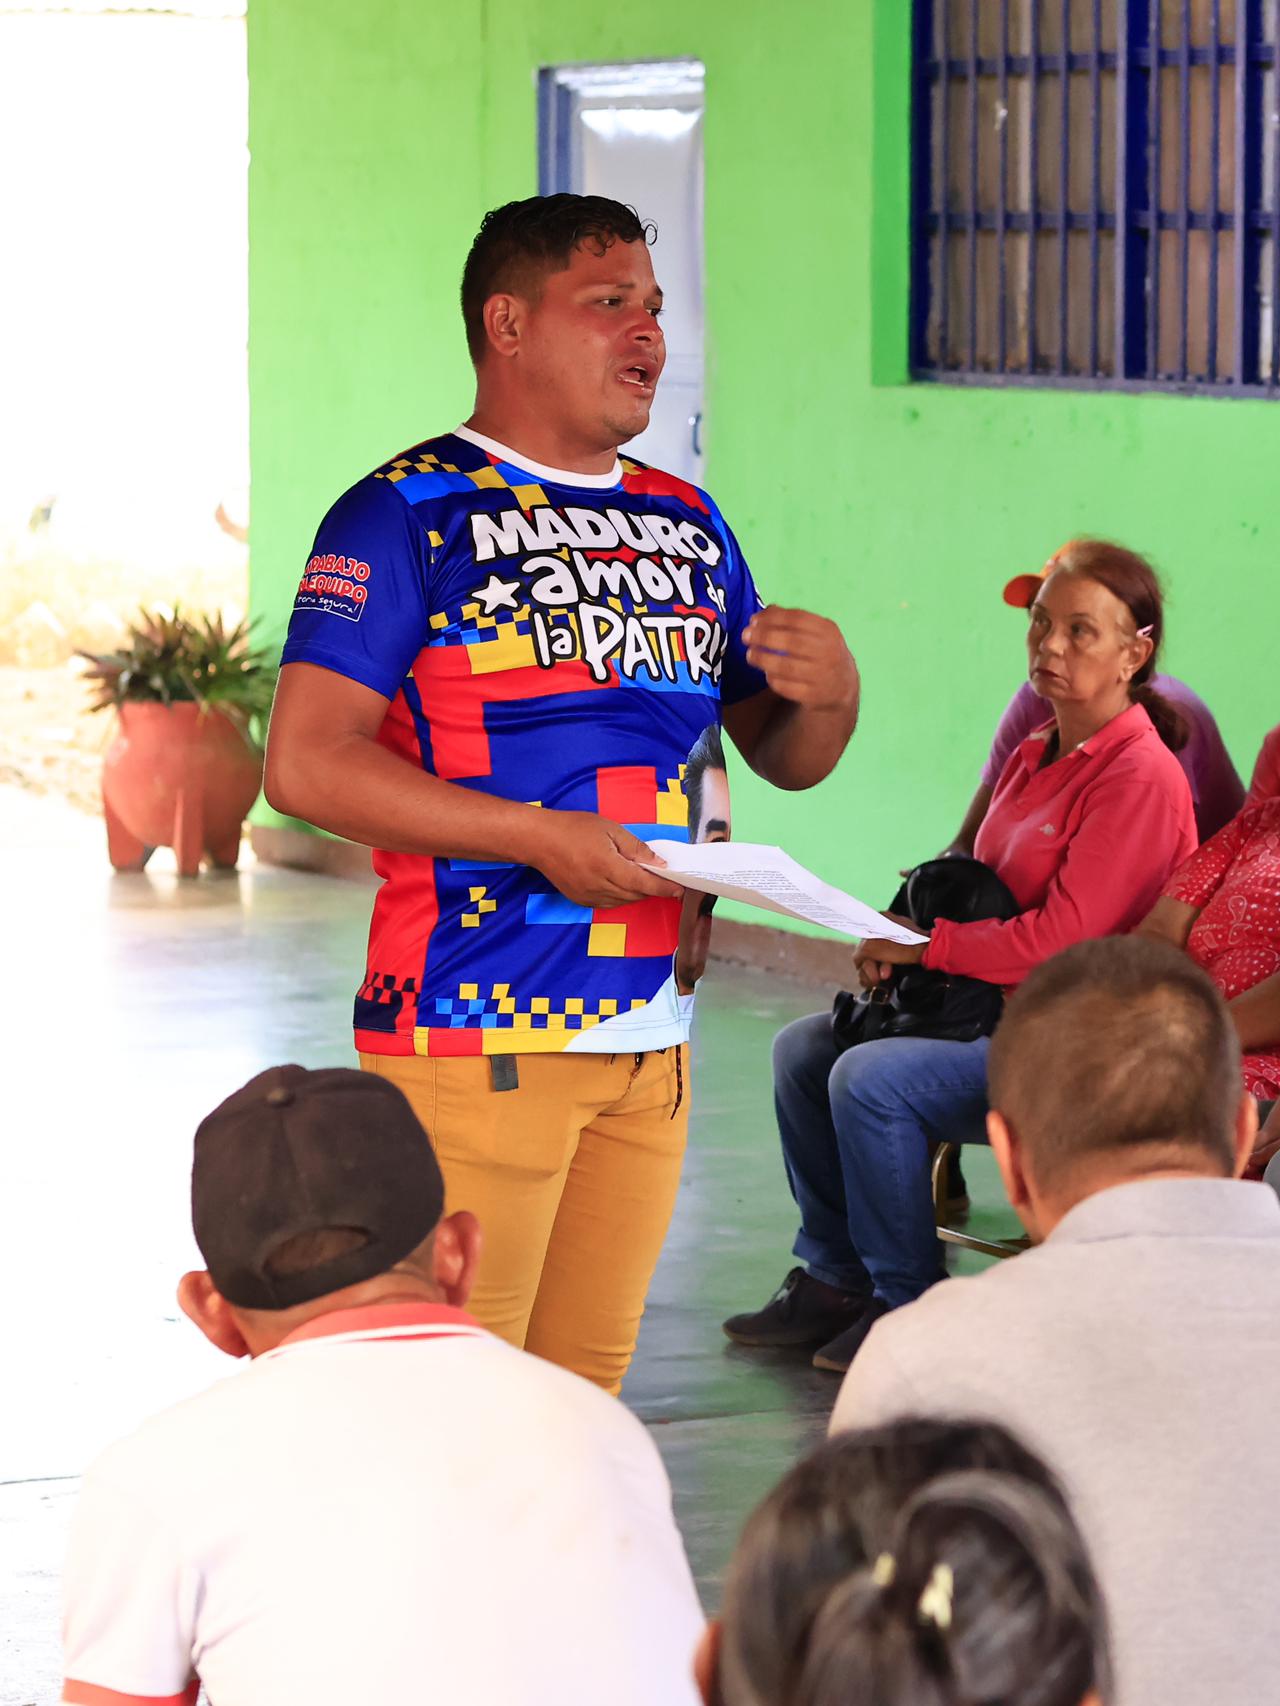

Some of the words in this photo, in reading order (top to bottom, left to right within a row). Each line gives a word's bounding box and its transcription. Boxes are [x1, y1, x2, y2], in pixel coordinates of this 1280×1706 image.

[471, 507, 721, 566] MADURO
[521, 551, 694, 606] amor
[534, 612, 573, 666] la
